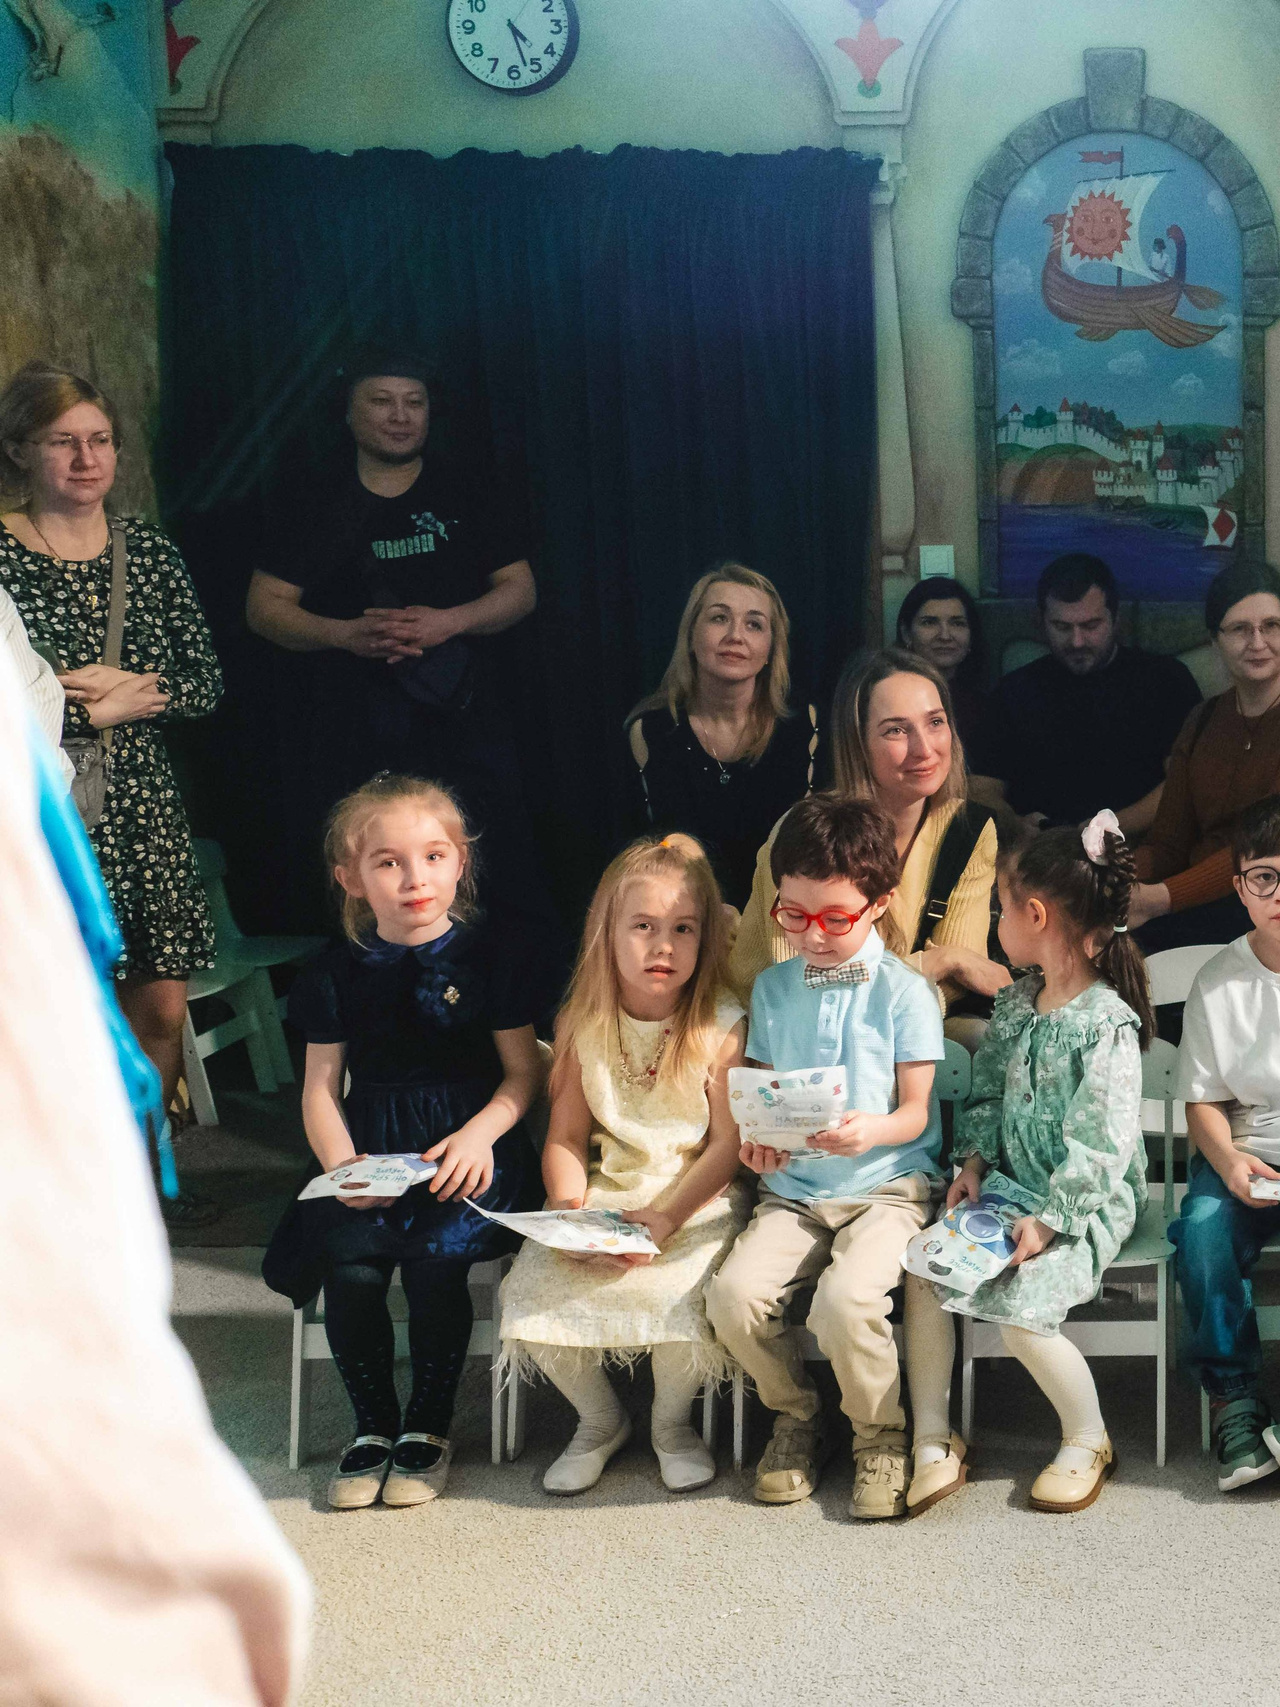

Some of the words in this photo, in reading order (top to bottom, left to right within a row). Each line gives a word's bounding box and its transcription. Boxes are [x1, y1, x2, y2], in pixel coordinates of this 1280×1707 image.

[467, 0, 486, 13] 10
[541, 0, 555, 13] 2
[461, 19, 476, 35] 9
[550, 19, 563, 35] 3
[470, 42, 484, 57] 8
[543, 42, 557, 57] 4
[487, 57, 499, 73] 7
[506, 64, 521, 80] 6
[529, 57, 543, 73] 5
